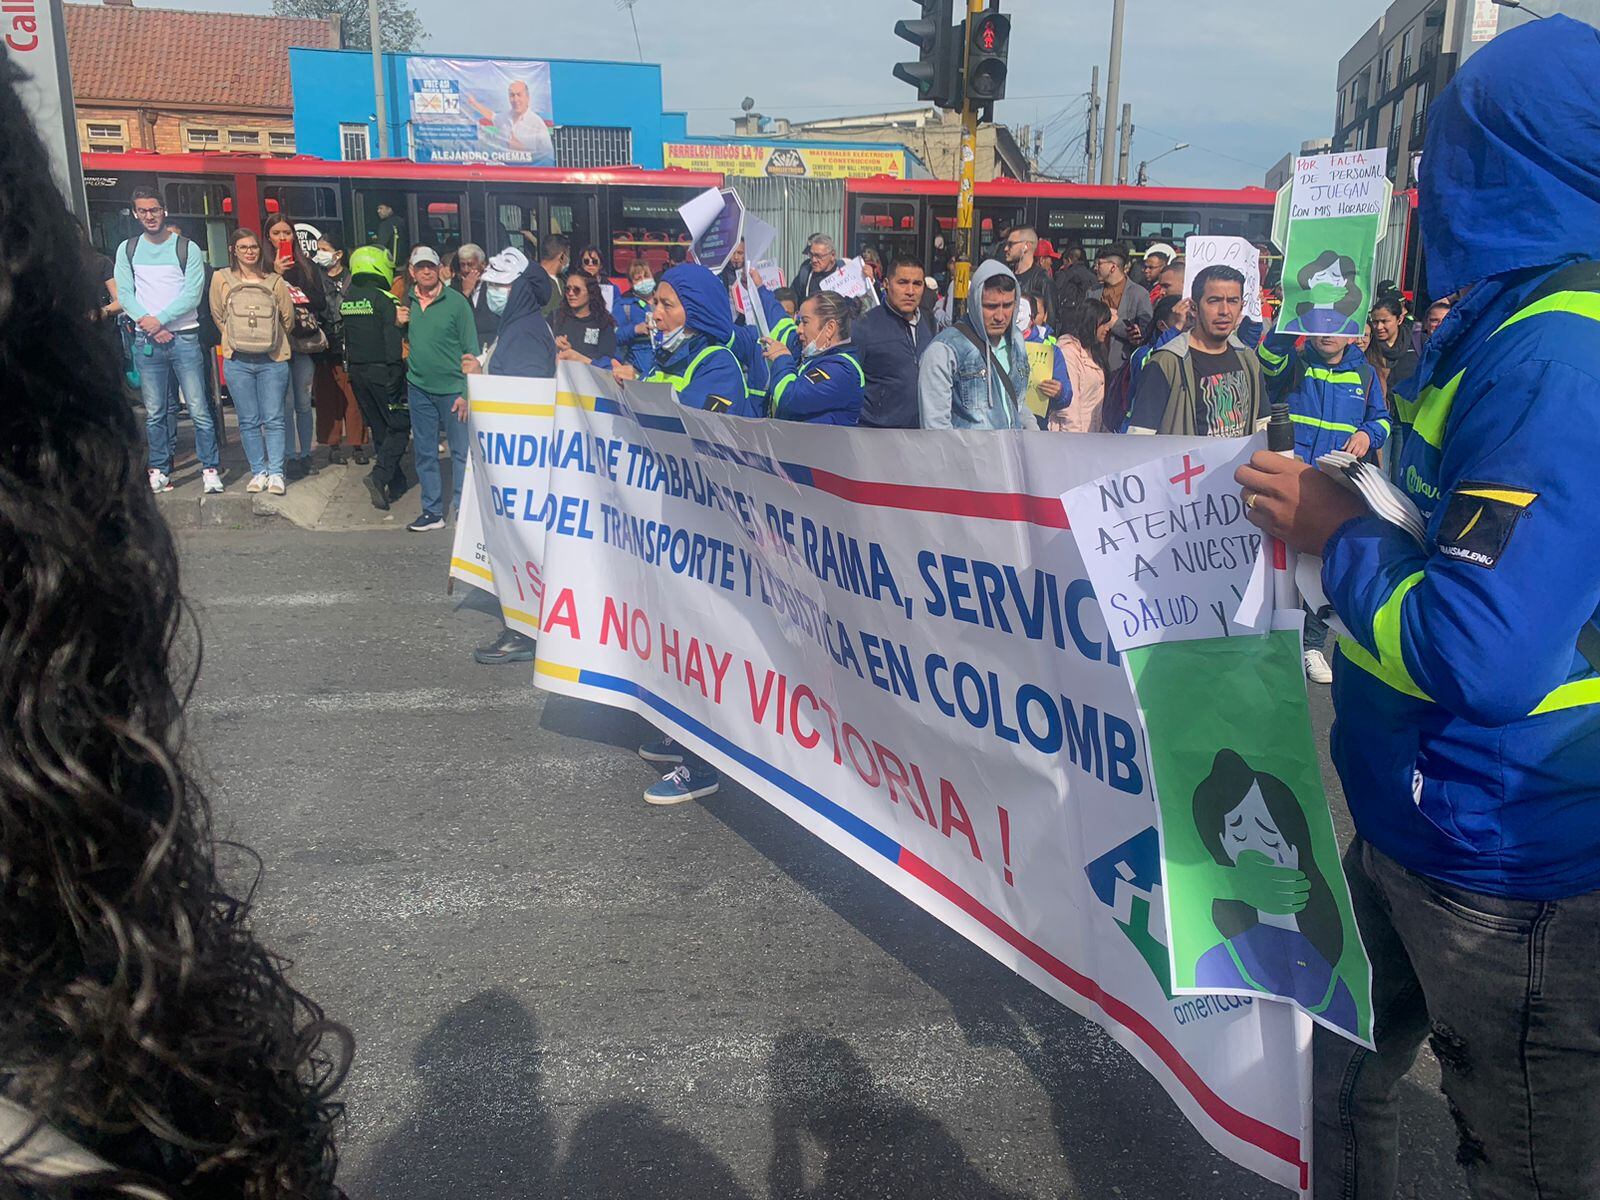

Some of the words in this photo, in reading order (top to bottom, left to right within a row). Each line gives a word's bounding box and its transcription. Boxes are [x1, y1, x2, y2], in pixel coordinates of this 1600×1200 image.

[431, 150, 489, 161] ALEJANDRO
[491, 151, 533, 162] CHEMAS
[1296, 158, 1319, 172] POR
[1300, 174, 1318, 184] DE
[1309, 181, 1370, 202] JUEGAN
[1314, 204, 1332, 217] MIS
[1338, 200, 1381, 214] HORARIOS
[299, 240, 318, 251] EVO
[1193, 241, 1217, 262] NO
[341, 298, 372, 310] POLICÍA
[1099, 474, 1145, 512] NO
[801, 516, 913, 620] RAMA,
[1128, 553, 1159, 582] A
[1111, 592, 1199, 638] SALUD
[490, 485, 517, 520] DE
[600, 502, 734, 591] TRANSPORTE
[858, 630, 920, 703] EN
[924, 653, 1149, 795] COLOMB
[599, 596, 651, 661] NO
[660, 622, 733, 704] HAY
[744, 659, 983, 863] VICTORIA
